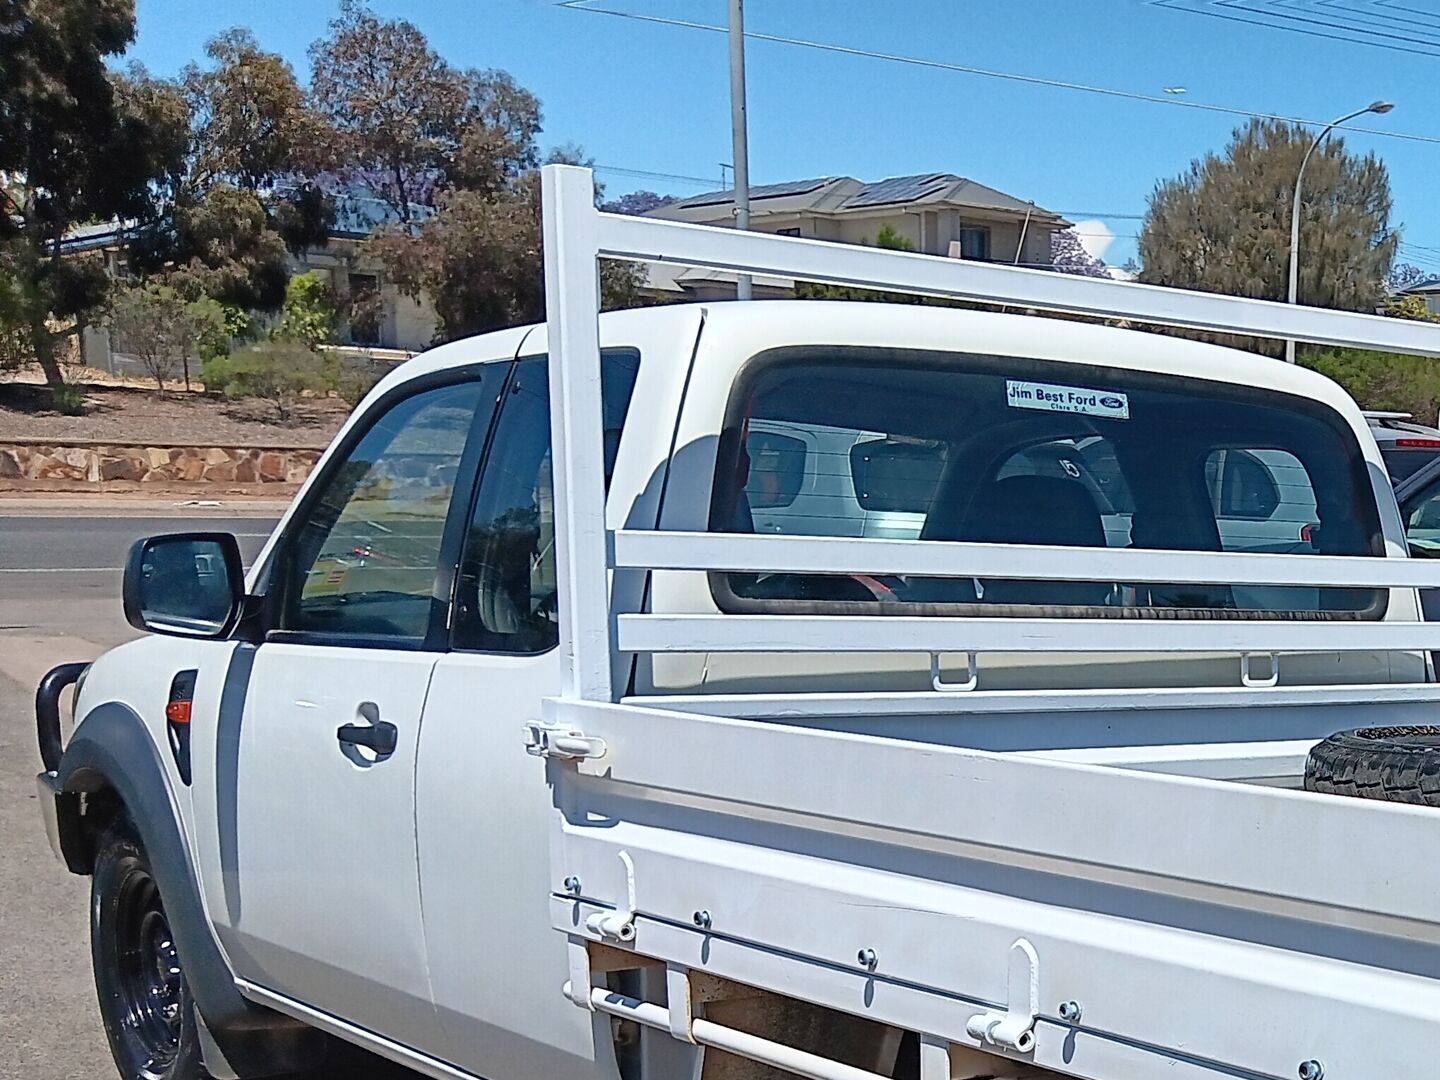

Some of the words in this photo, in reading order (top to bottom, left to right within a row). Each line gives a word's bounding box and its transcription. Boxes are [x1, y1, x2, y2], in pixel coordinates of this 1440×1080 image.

[1009, 387, 1032, 400] Jim
[1036, 389, 1064, 403] Best
[1068, 392, 1097, 407] Ford
